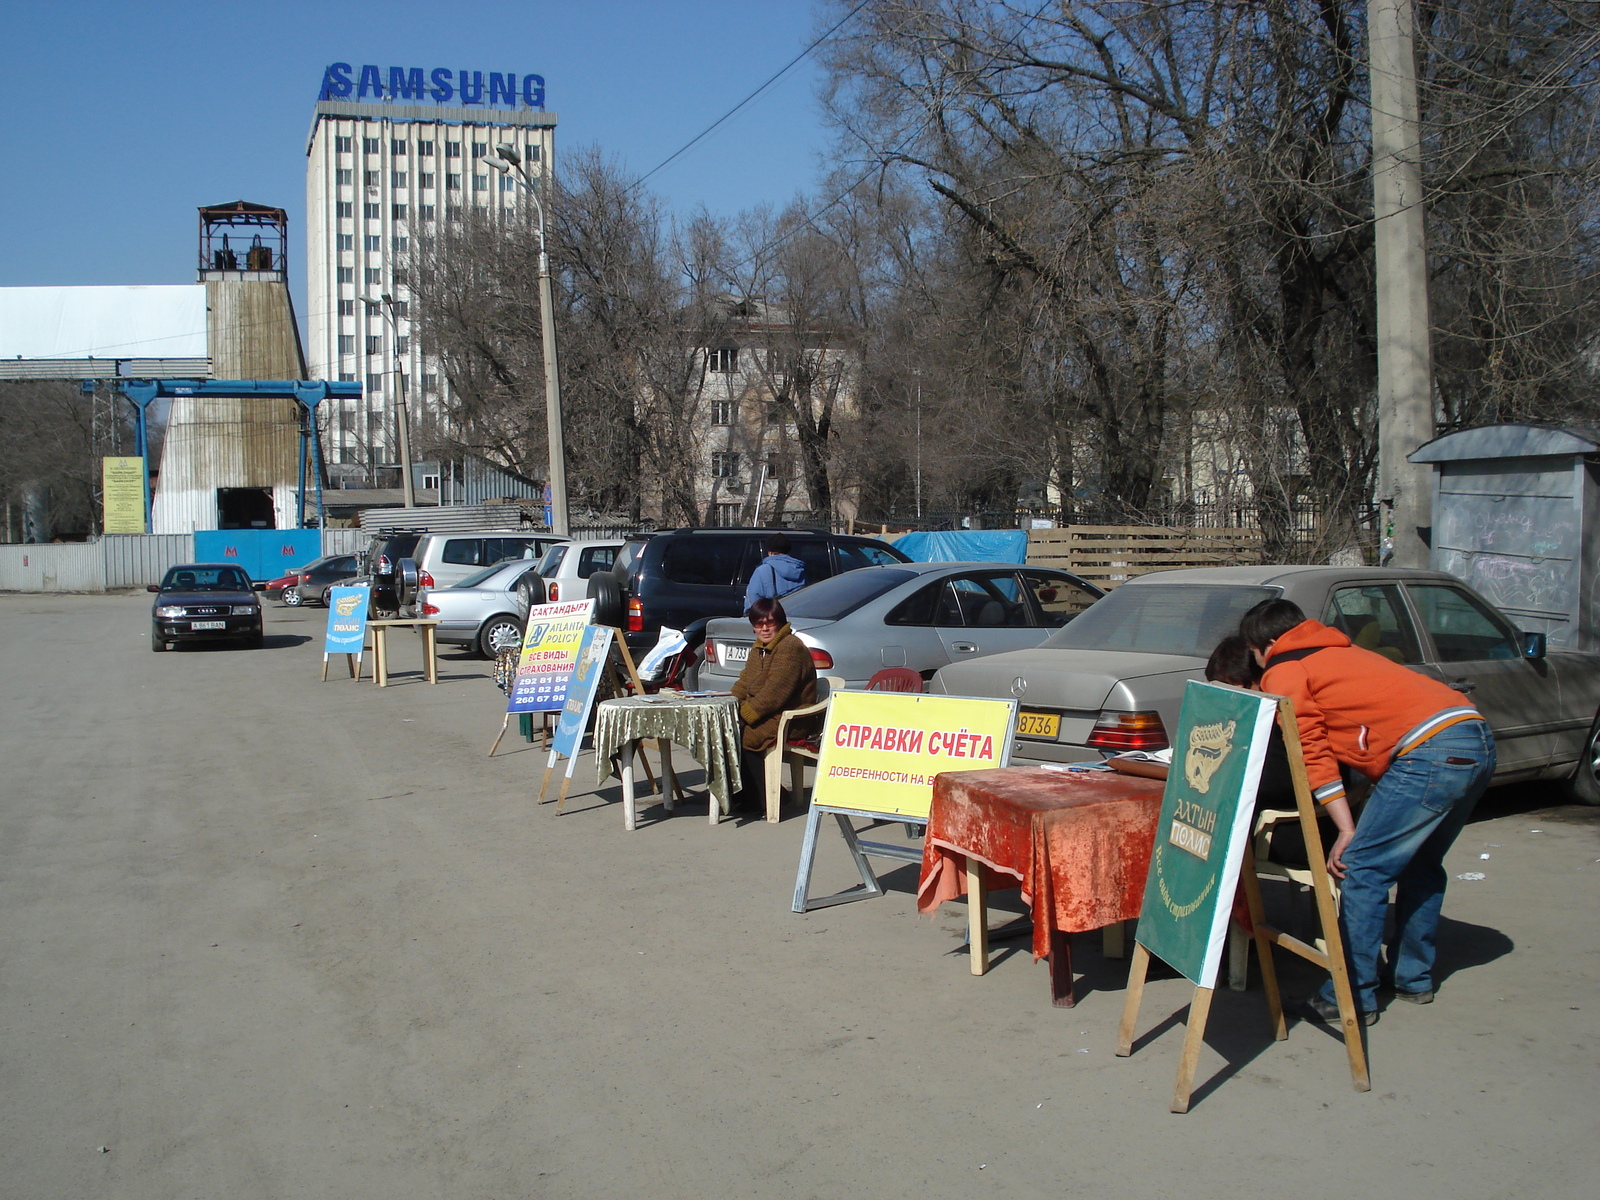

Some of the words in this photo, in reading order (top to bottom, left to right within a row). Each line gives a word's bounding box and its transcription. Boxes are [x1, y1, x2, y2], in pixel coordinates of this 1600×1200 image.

[329, 62, 545, 107] SAMSUNG
[550, 622, 584, 632] ATLANTA
[546, 633, 578, 644] POLICY
[528, 652, 542, 662] ВСЕ
[543, 650, 568, 660] ВИДЫ
[728, 647, 733, 659] A
[735, 647, 747, 660] 733
[520, 663, 574, 675] СТРАХОВАНИЯ
[834, 724, 922, 754] СПРАВКИ
[928, 728, 994, 760] СЧЁТА
[829, 766, 909, 784] ДОВЕРЕННОСТИ
[910, 774, 924, 785] НА
[1174, 798, 1216, 833] АЛТЫН
[1170, 822, 1210, 856] ПОЛИС
